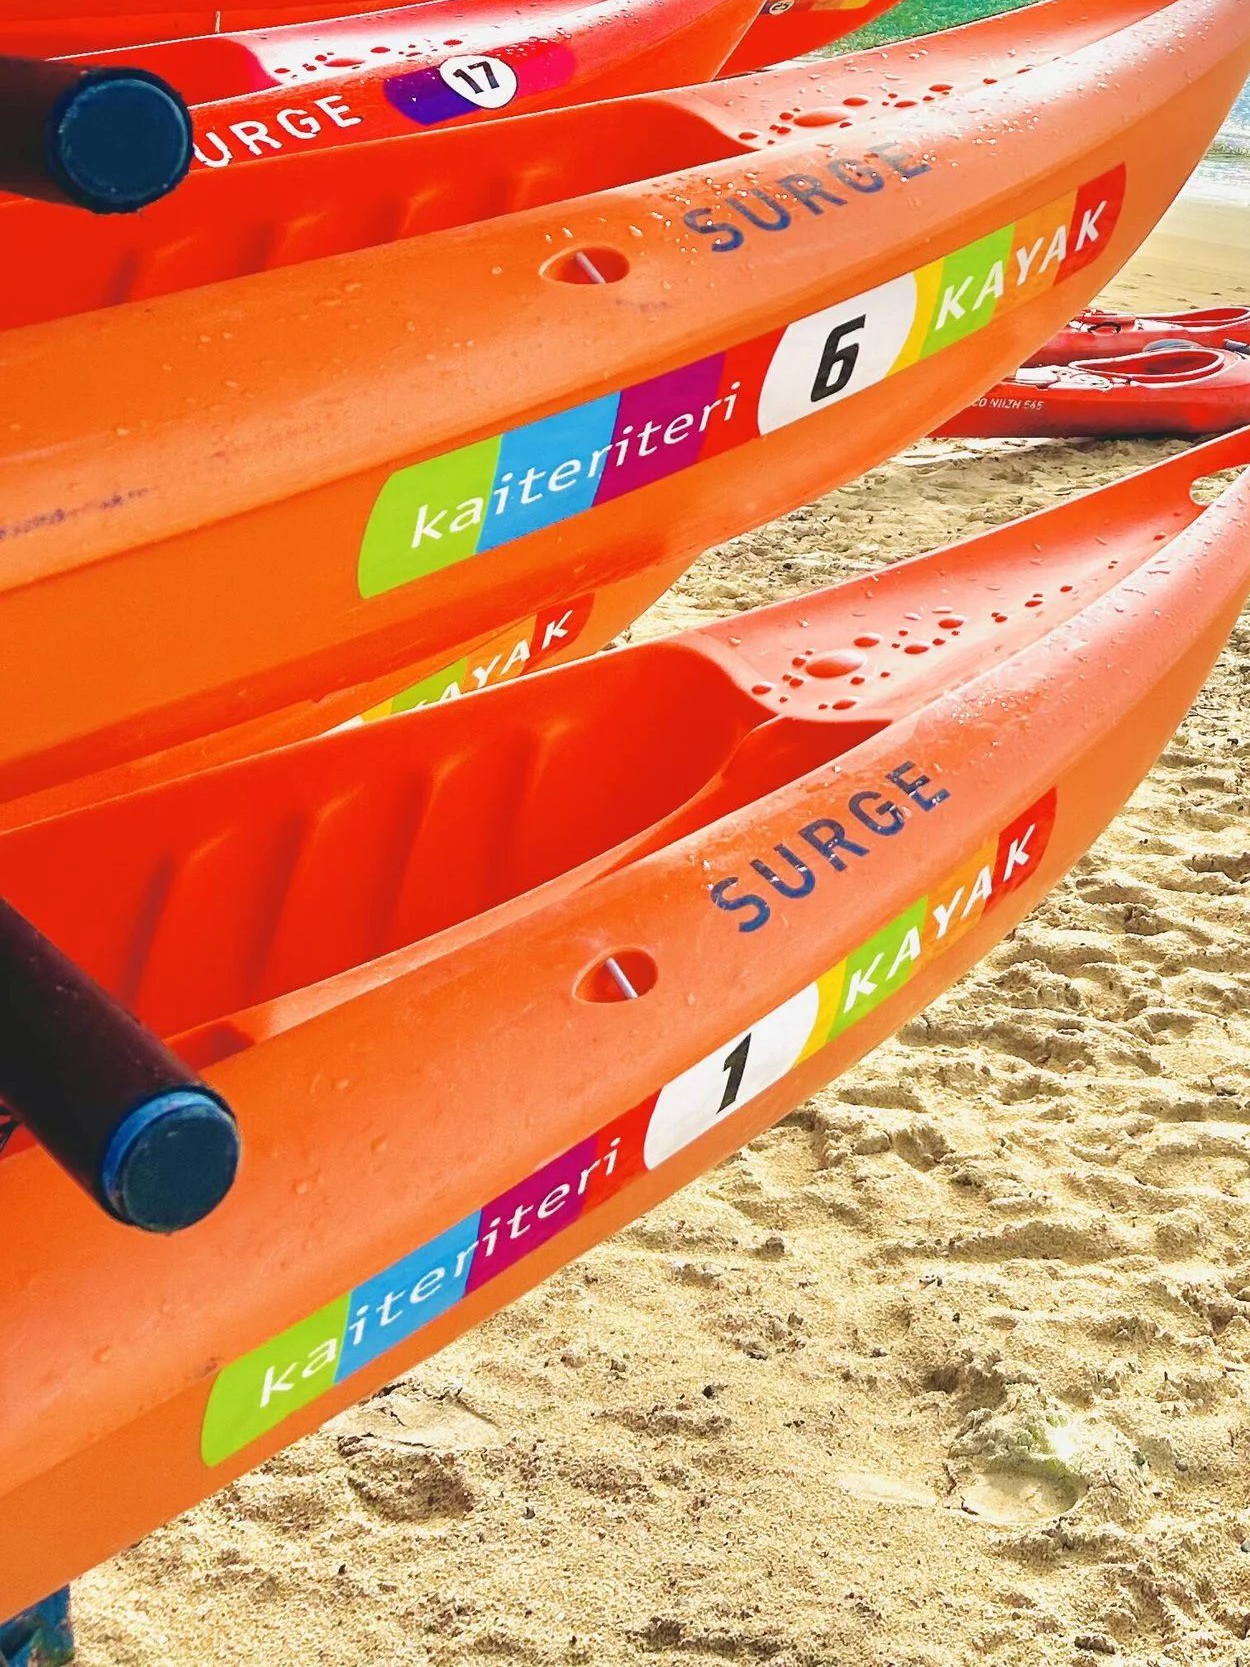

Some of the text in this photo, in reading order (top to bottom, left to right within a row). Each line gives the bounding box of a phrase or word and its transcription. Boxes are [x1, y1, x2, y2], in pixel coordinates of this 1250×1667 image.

[193, 94, 364, 168] URGE
[452, 60, 501, 95] 17
[683, 140, 933, 253] SURGE
[410, 199, 1108, 548] kaiteriteri 6 KAYAK
[416, 609, 574, 707] AYAK
[709, 760, 950, 934] SURGE
[259, 823, 1037, 1409] kaiteriteri 1 KAYAK
